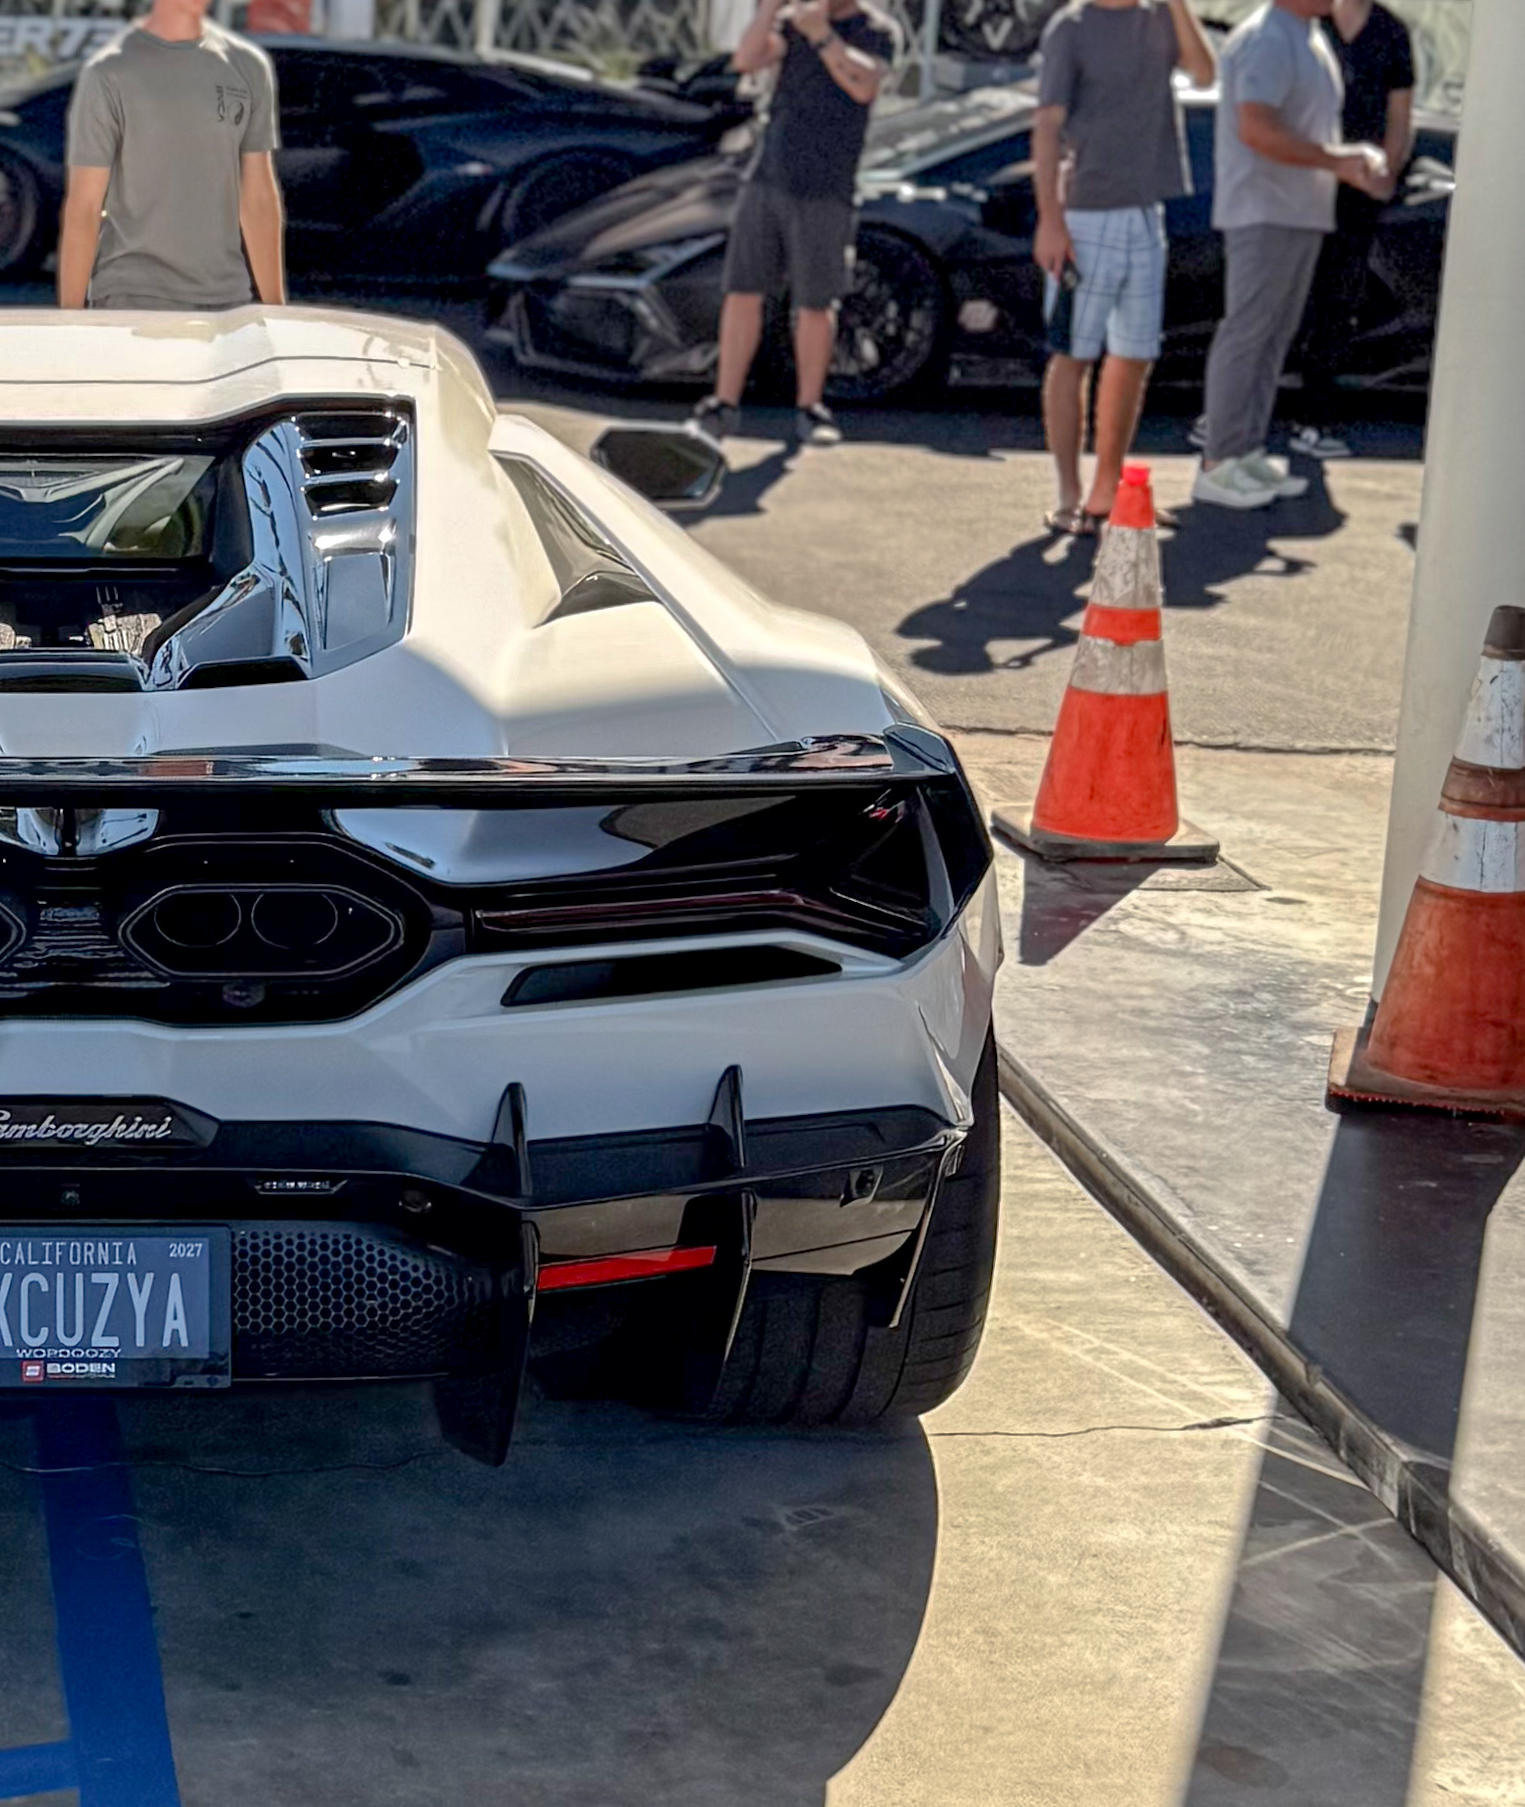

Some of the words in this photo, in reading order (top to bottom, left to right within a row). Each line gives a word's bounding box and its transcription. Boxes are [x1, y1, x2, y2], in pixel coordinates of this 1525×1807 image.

[0, 1241, 138, 1266] CALIFORNIA
[168, 1242, 203, 1258] 2027
[46, 1362, 116, 1374] BODEN
